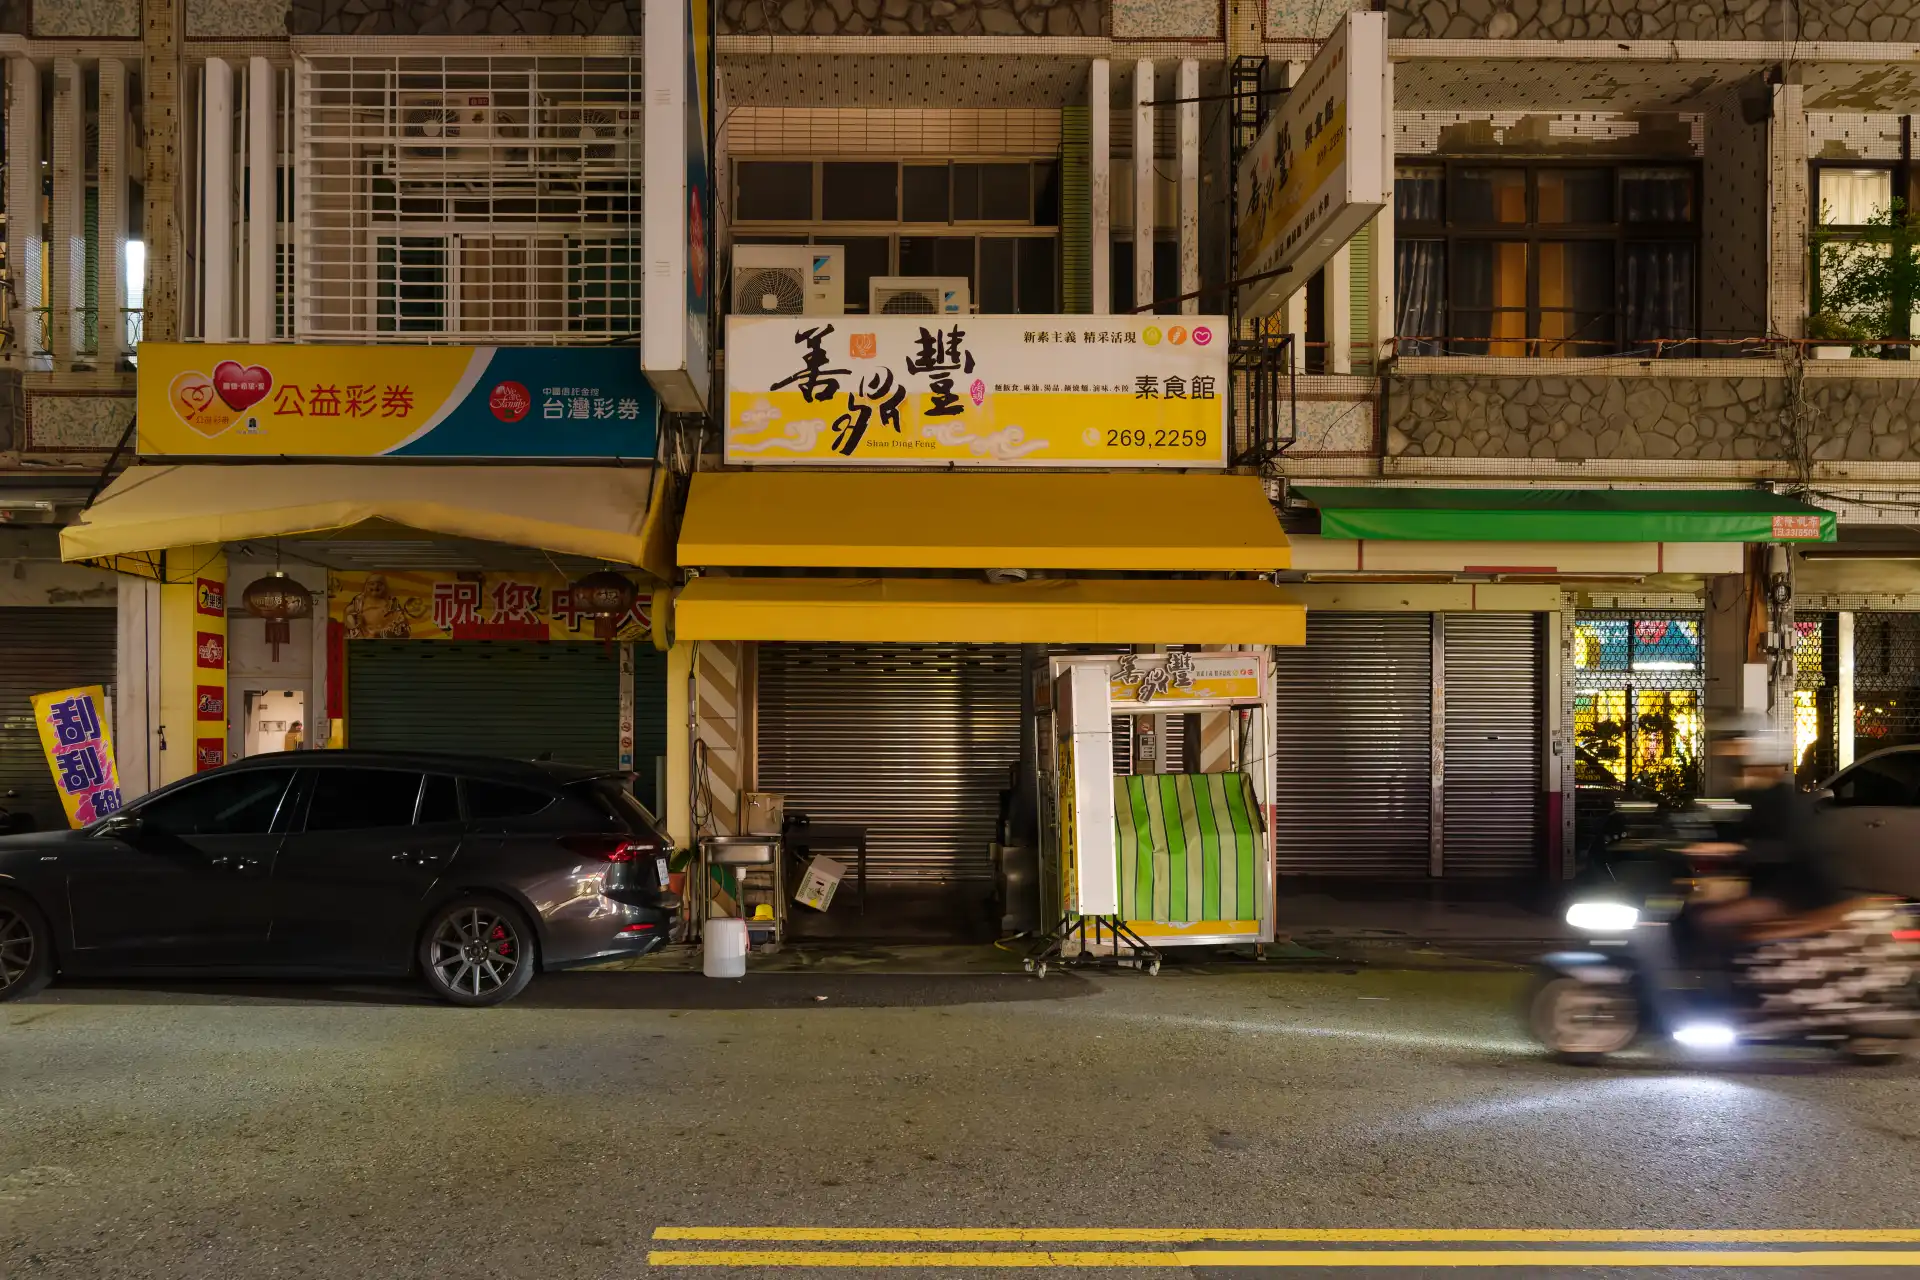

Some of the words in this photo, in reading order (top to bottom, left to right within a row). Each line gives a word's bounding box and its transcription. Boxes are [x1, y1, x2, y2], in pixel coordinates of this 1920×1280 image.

[1023, 331, 1076, 344] 新素主義
[1083, 331, 1137, 344] 精采活現
[542, 387, 600, 398] 中國信託金控
[1134, 374, 1215, 400] 素食館
[274, 384, 415, 418] 公益彩券
[542, 397, 640, 421] 台灣彩券
[867, 439, 890, 447] Shan
[892, 439, 912, 449] Ding
[915, 439, 936, 449] Feng
[1107, 429, 1206, 450] 269,2259
